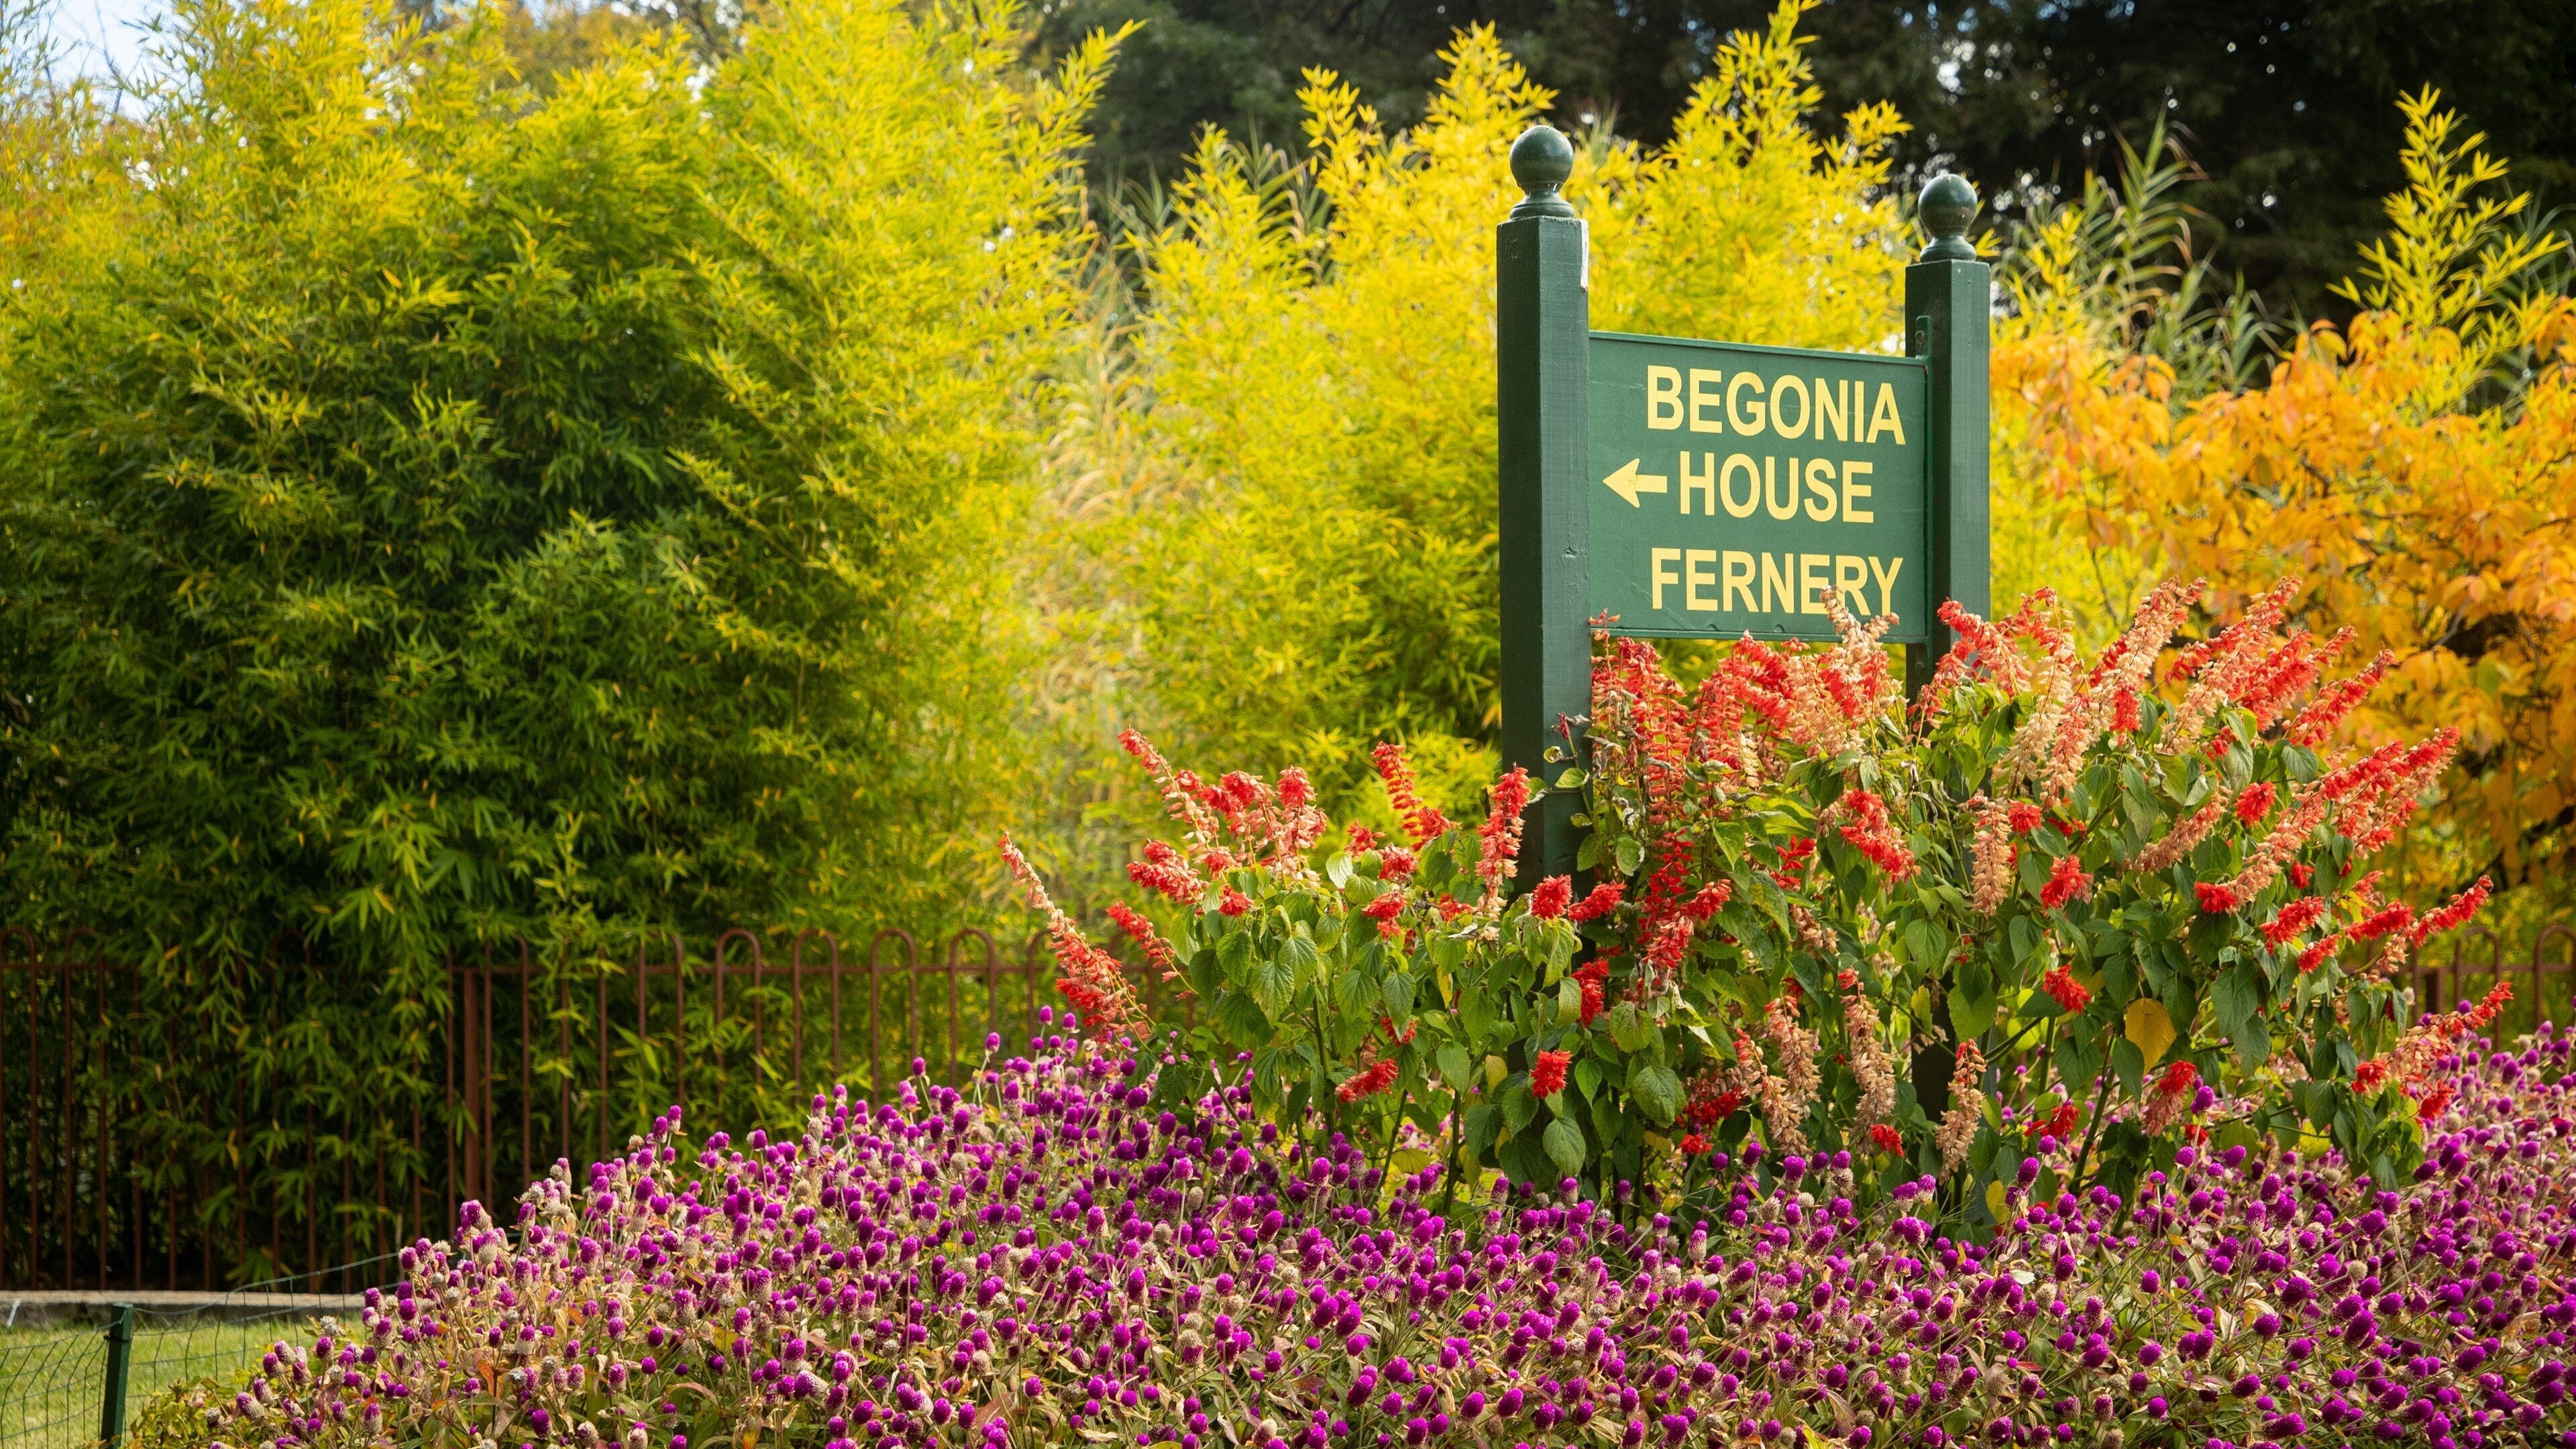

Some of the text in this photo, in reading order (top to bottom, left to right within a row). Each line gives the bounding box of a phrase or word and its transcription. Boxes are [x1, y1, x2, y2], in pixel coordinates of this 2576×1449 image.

[1647, 364, 1906, 445] BEGONIA
[1680, 451, 1874, 523] HOUSE
[1651, 547, 1904, 616] FERNERY
